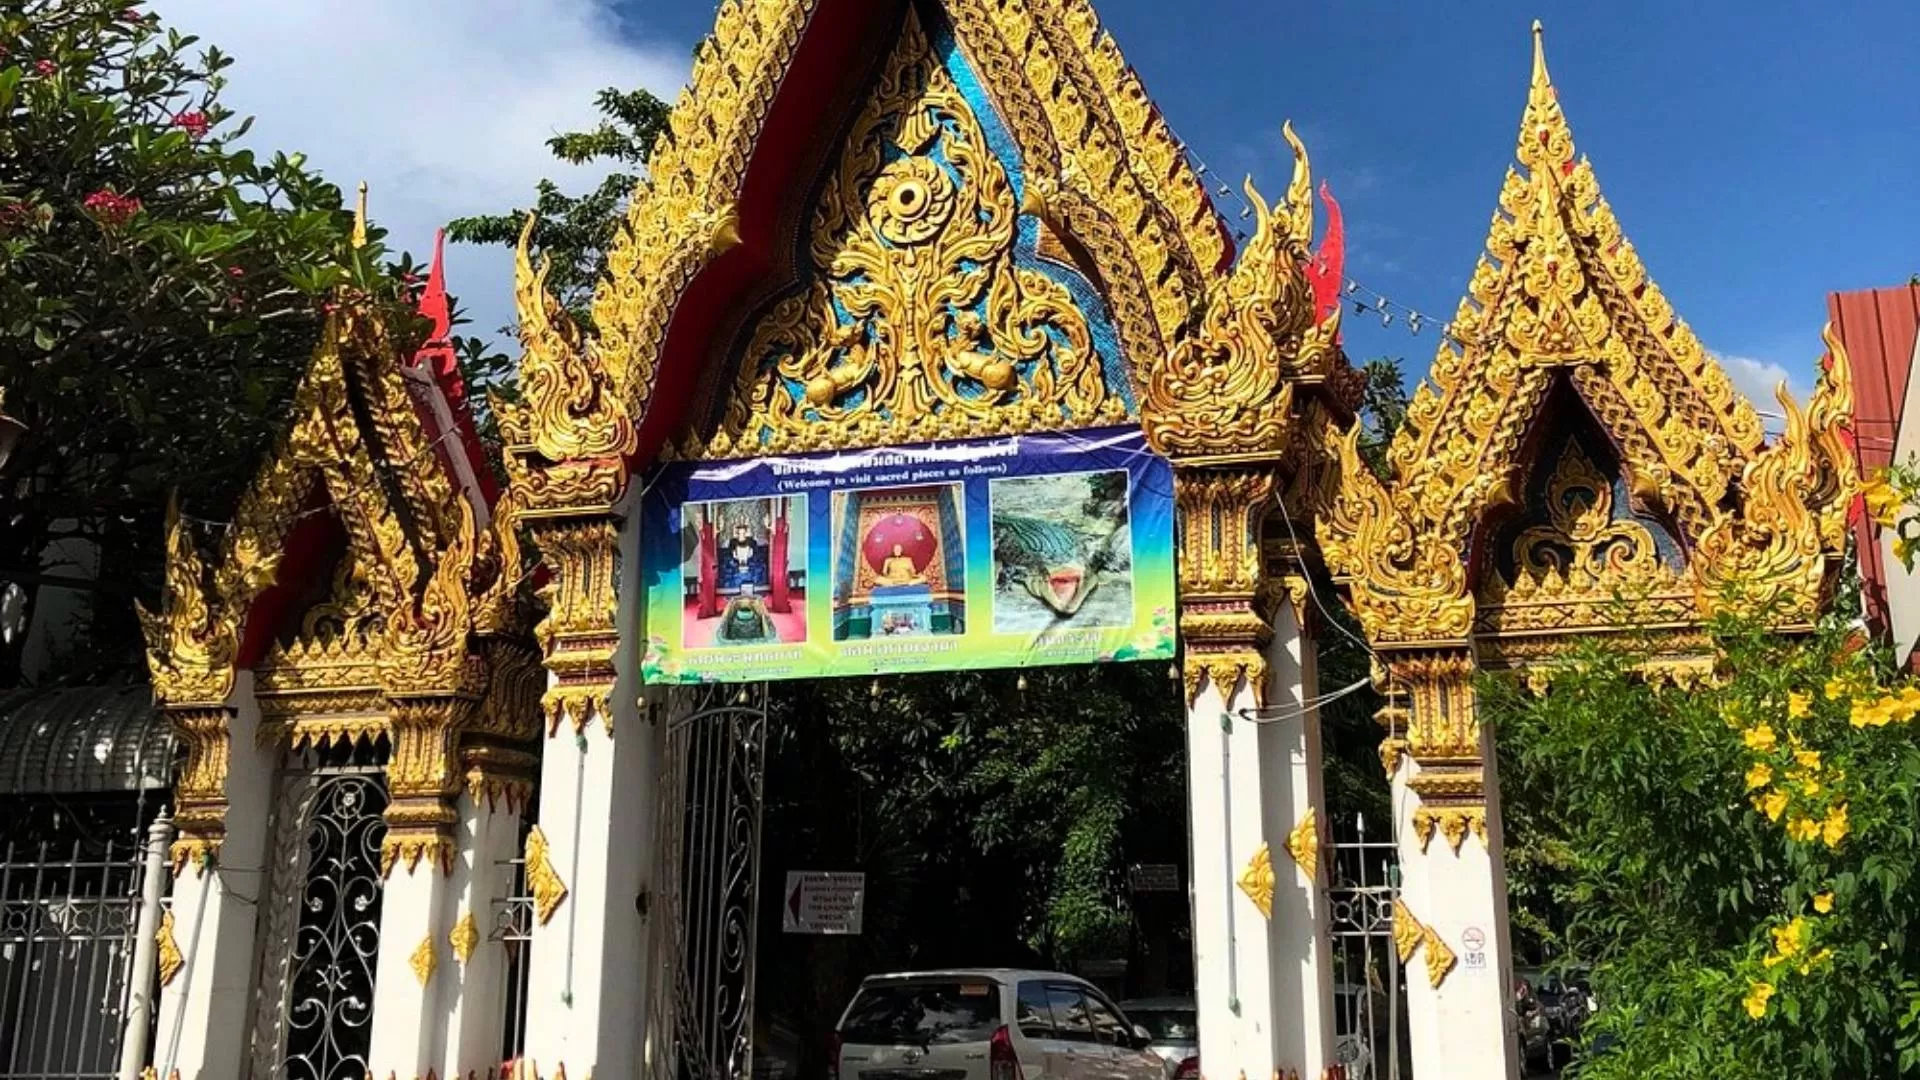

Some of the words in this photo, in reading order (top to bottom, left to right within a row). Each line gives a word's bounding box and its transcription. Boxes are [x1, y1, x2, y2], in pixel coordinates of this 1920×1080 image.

[777, 479, 831, 491] (Welcome
[835, 478, 846, 486] to
[850, 474, 871, 484] visit
[875, 471, 909, 482] sacred
[912, 469, 945, 482] places
[948, 467, 960, 476] as
[963, 463, 1007, 475] follows)
